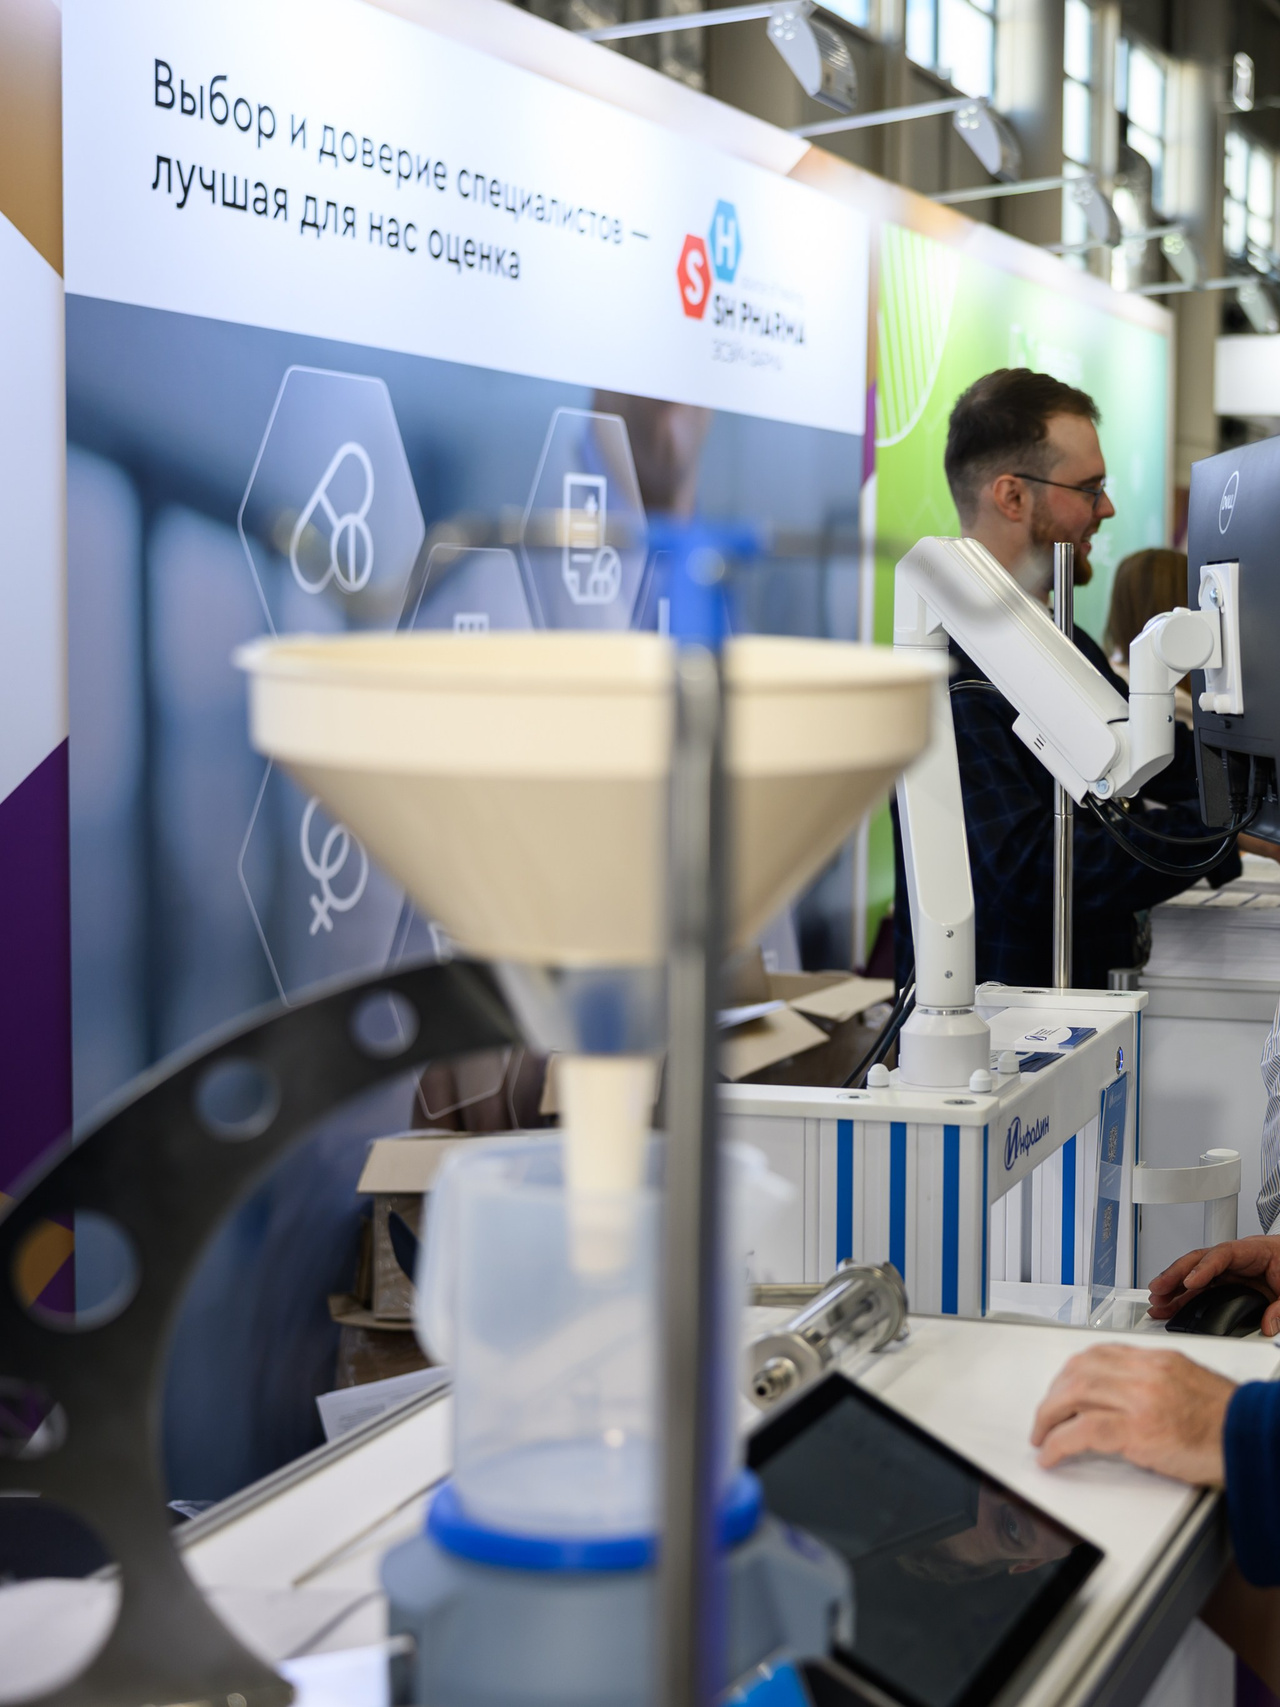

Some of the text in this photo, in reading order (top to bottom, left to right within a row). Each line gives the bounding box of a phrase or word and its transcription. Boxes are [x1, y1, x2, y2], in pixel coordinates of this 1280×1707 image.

[154, 58, 276, 148] Выбор
[291, 114, 306, 150] и
[318, 125, 447, 190] доверие
[457, 169, 623, 245] специалистов
[152, 154, 521, 280] лучшая для нас оценка
[714, 294, 737, 331] SH
[739, 302, 806, 345] PHARMA
